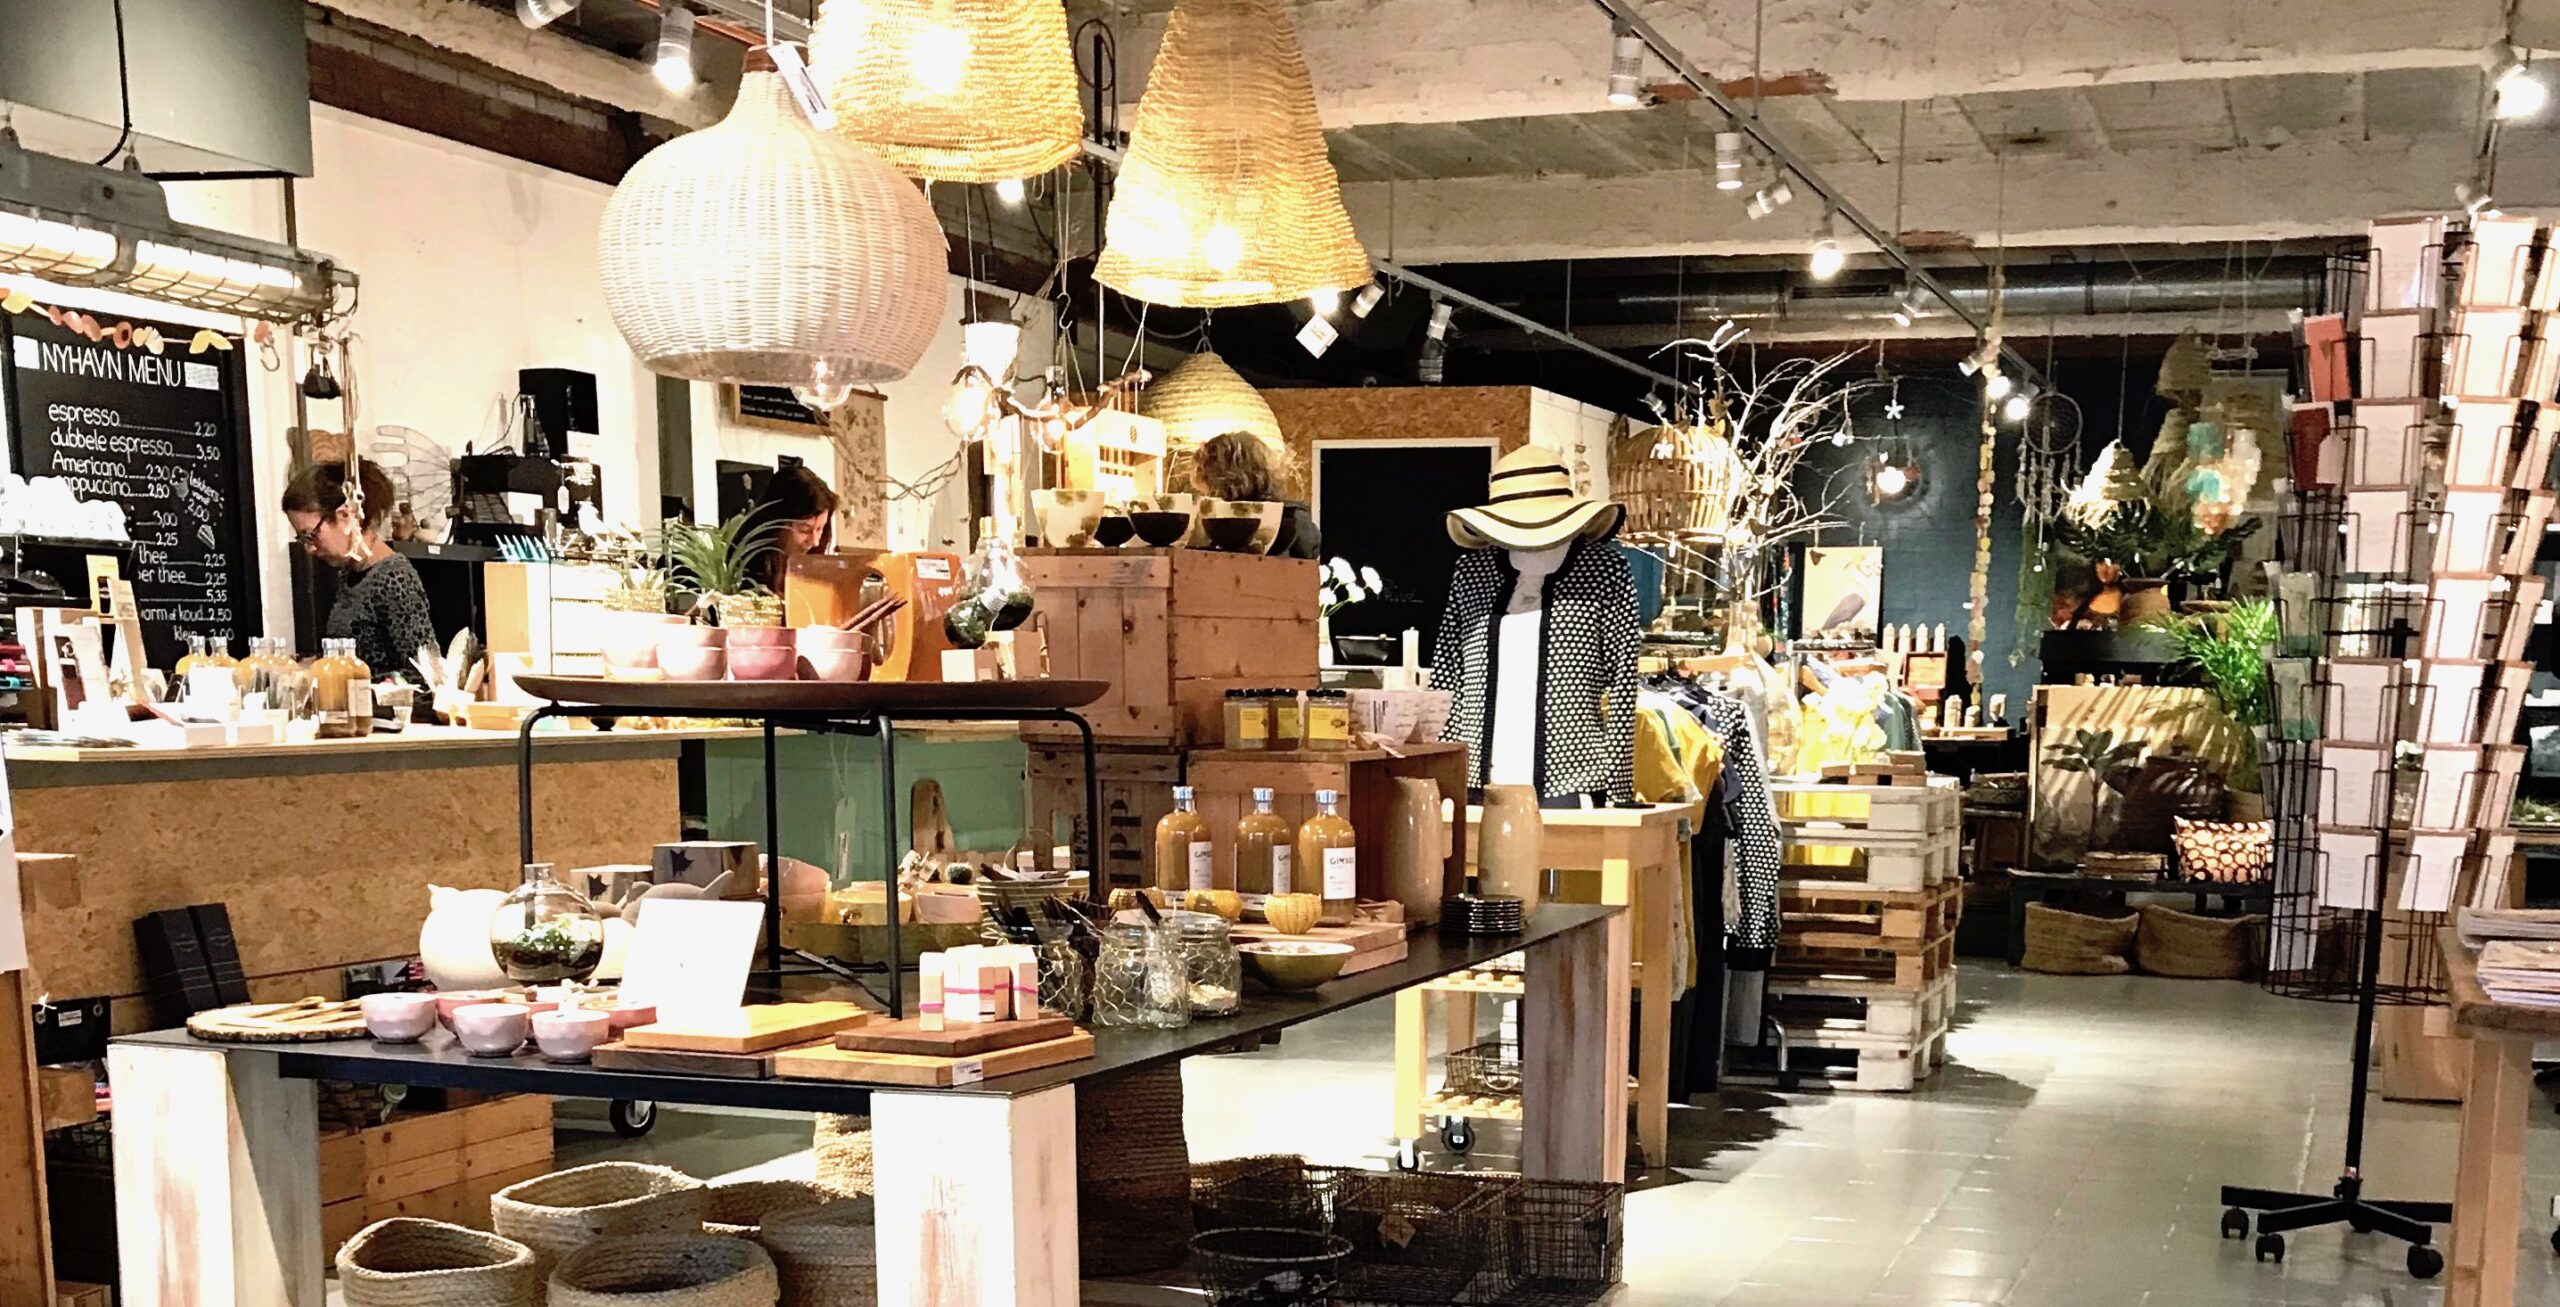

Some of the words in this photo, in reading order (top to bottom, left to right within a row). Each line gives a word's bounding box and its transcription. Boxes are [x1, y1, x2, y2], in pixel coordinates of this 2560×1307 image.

[43, 342, 122, 381] NYHAVN
[128, 353, 182, 387] MENU
[49, 403, 121, 434] espresso
[194, 421, 218, 438] 2,20
[50, 427, 108, 452] dubbele
[110, 435, 174, 464] espresso
[196, 444, 221, 461] 3,50
[52, 450, 126, 478] Americano
[65, 476, 131, 501] ppuccino
[139, 542, 167, 564] thee
[138, 569, 155, 582] er
[158, 566, 186, 584] thee
[178, 603, 204, 622] koud
